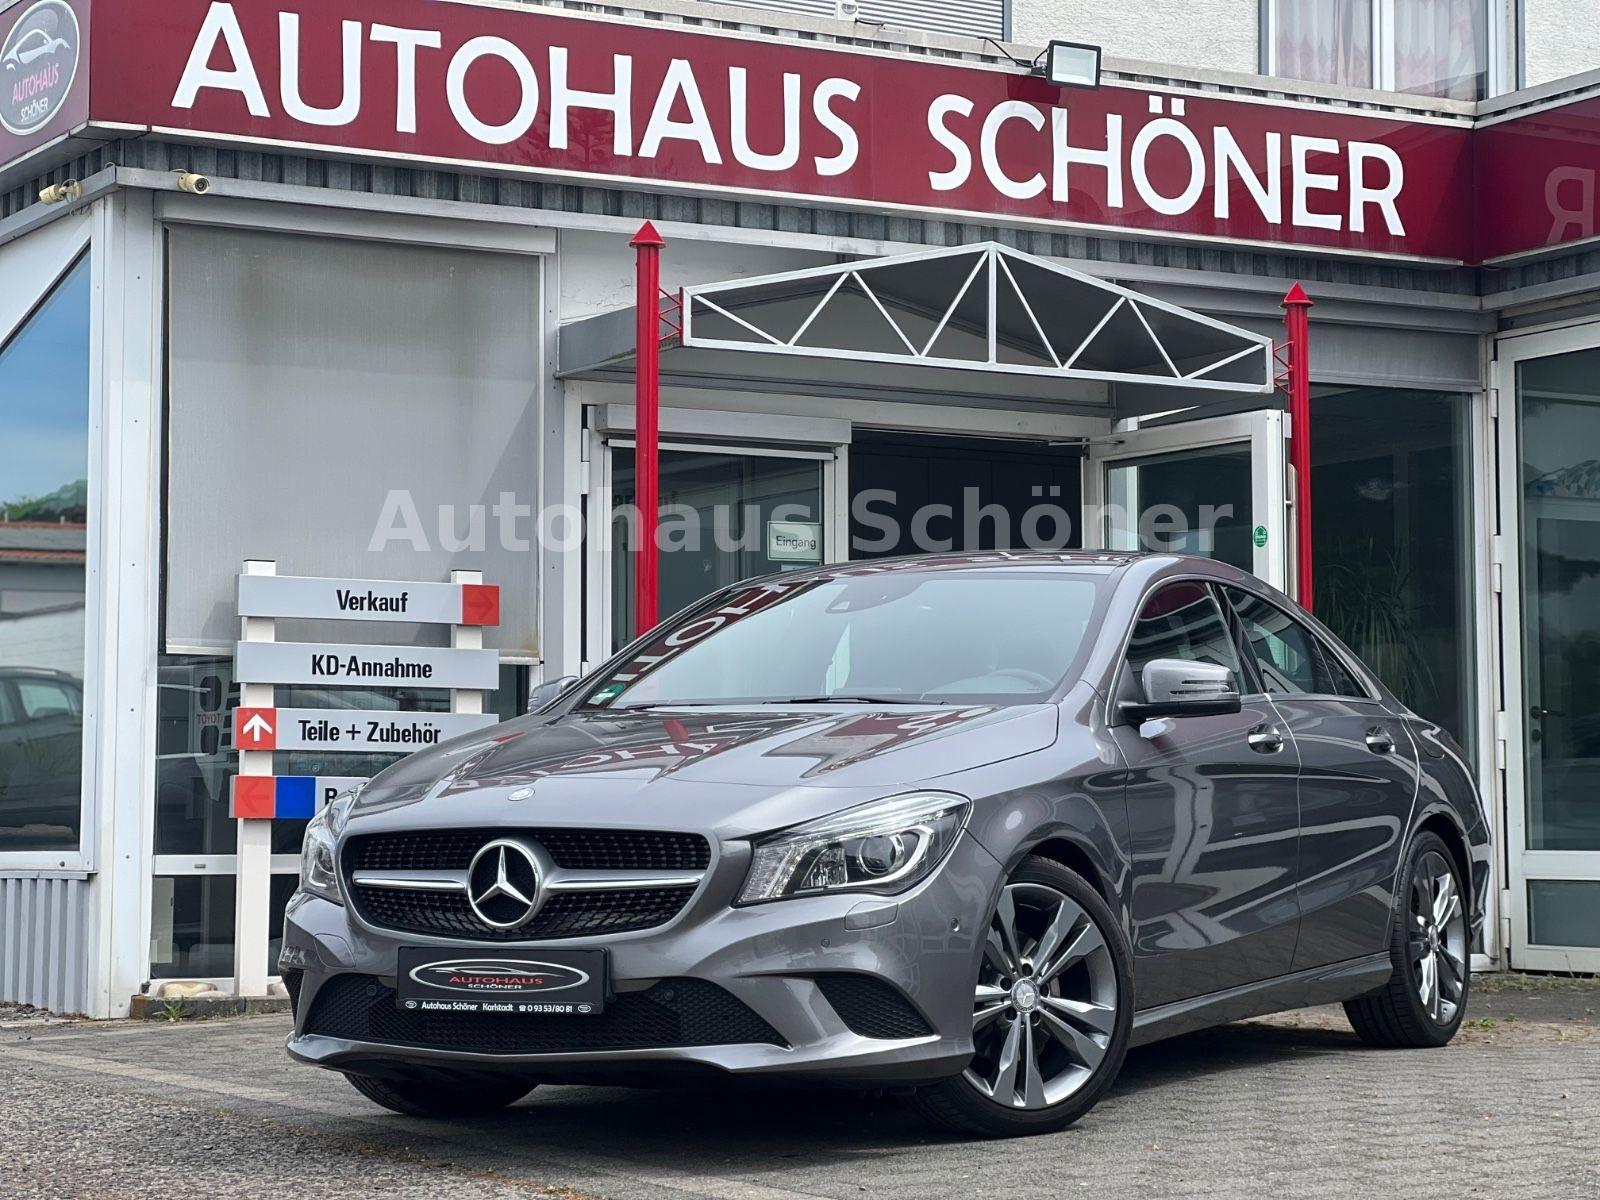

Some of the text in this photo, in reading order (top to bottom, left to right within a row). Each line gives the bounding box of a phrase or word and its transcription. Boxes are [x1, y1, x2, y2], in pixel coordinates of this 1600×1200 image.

[11, 63, 59, 104] AUTOHAUS
[20, 97, 49, 122] SCHÖNER
[172, 1, 862, 177] AUTOHAUS
[927, 94, 1406, 237] SCHÖNER
[775, 535, 817, 551] Eingang
[336, 589, 409, 612] Verkauf
[311, 654, 433, 679] KD-Annahme
[298, 719, 442, 744] Teile + Zubehör
[449, 976, 544, 984] AUTOHAUS
[421, 1001, 452, 1010] Autohaus
[452, 1002, 478, 1011] Schöner
[482, 1003, 514, 1012] Karlstadt
